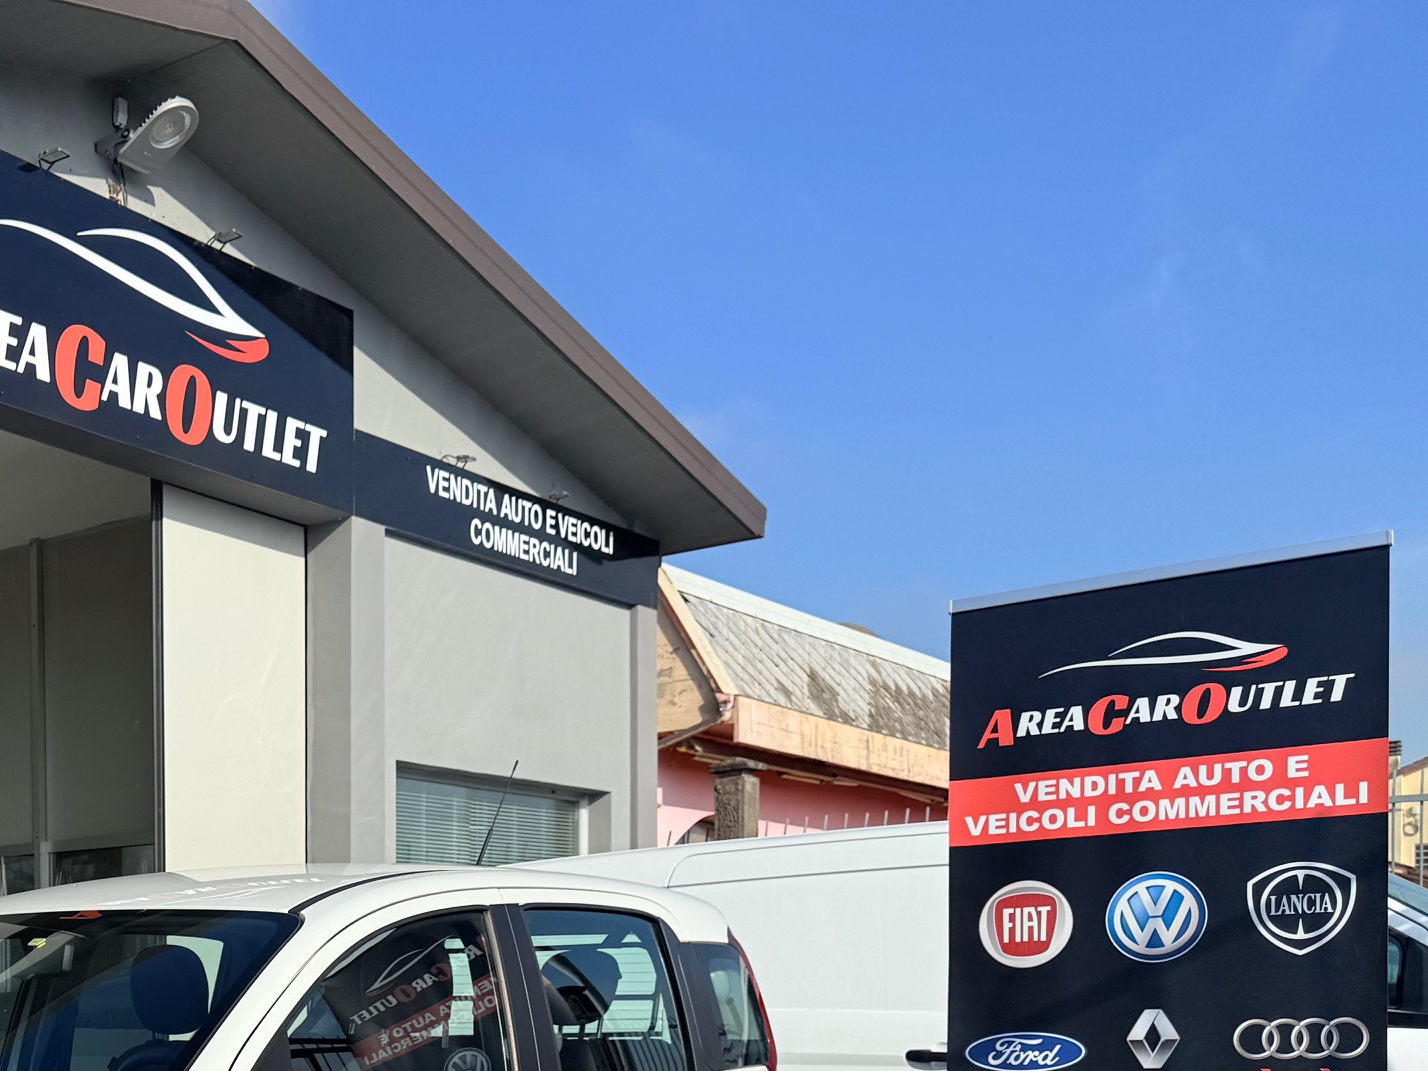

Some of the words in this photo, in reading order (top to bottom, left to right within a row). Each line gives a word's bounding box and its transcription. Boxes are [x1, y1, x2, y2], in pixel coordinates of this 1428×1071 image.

[425, 464, 497, 515] VENDITA
[500, 493, 542, 531] AUTO
[546, 508, 557, 535] E
[558, 512, 614, 555] VEICOLI
[470, 518, 578, 576] COMMERCIALI
[1014, 770, 1162, 803] VENDITA
[1172, 758, 1274, 789] AUTO
[1287, 754, 1310, 778] E
[964, 807, 1096, 837] VEICOLI
[1107, 782, 1369, 825] COMMERCIALI
[1002, 905, 1051, 943] FIAT
[1269, 892, 1335, 915] LANCIA
[988, 1038, 1062, 1066] Ford
